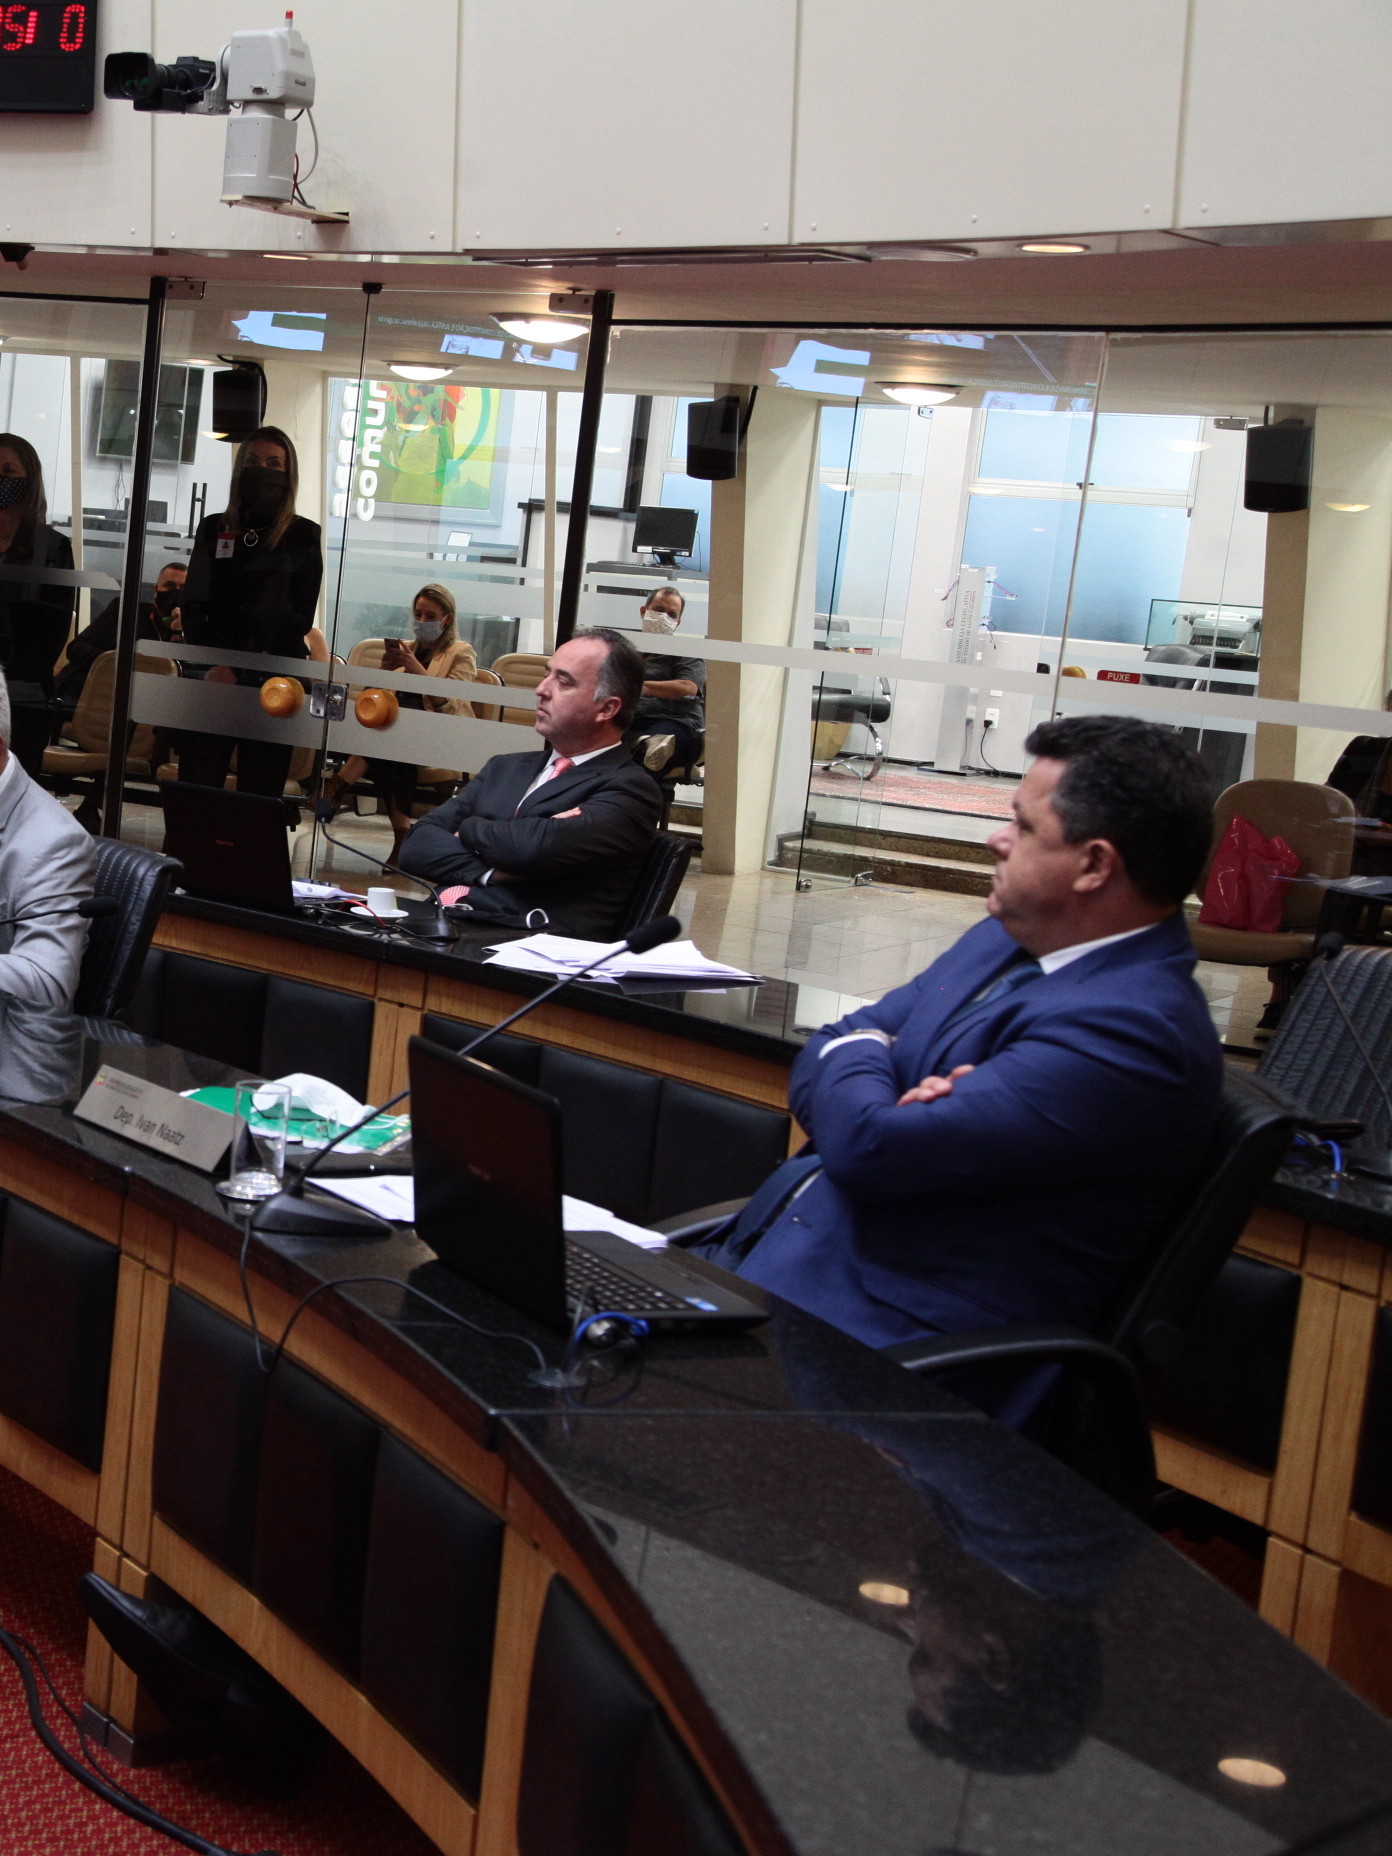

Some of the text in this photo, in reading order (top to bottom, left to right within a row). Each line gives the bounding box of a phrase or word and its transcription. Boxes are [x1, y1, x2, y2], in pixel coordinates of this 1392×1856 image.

[1107, 672, 1131, 682] PUXE
[113, 1105, 185, 1146] Dep. Ivan Naatz
